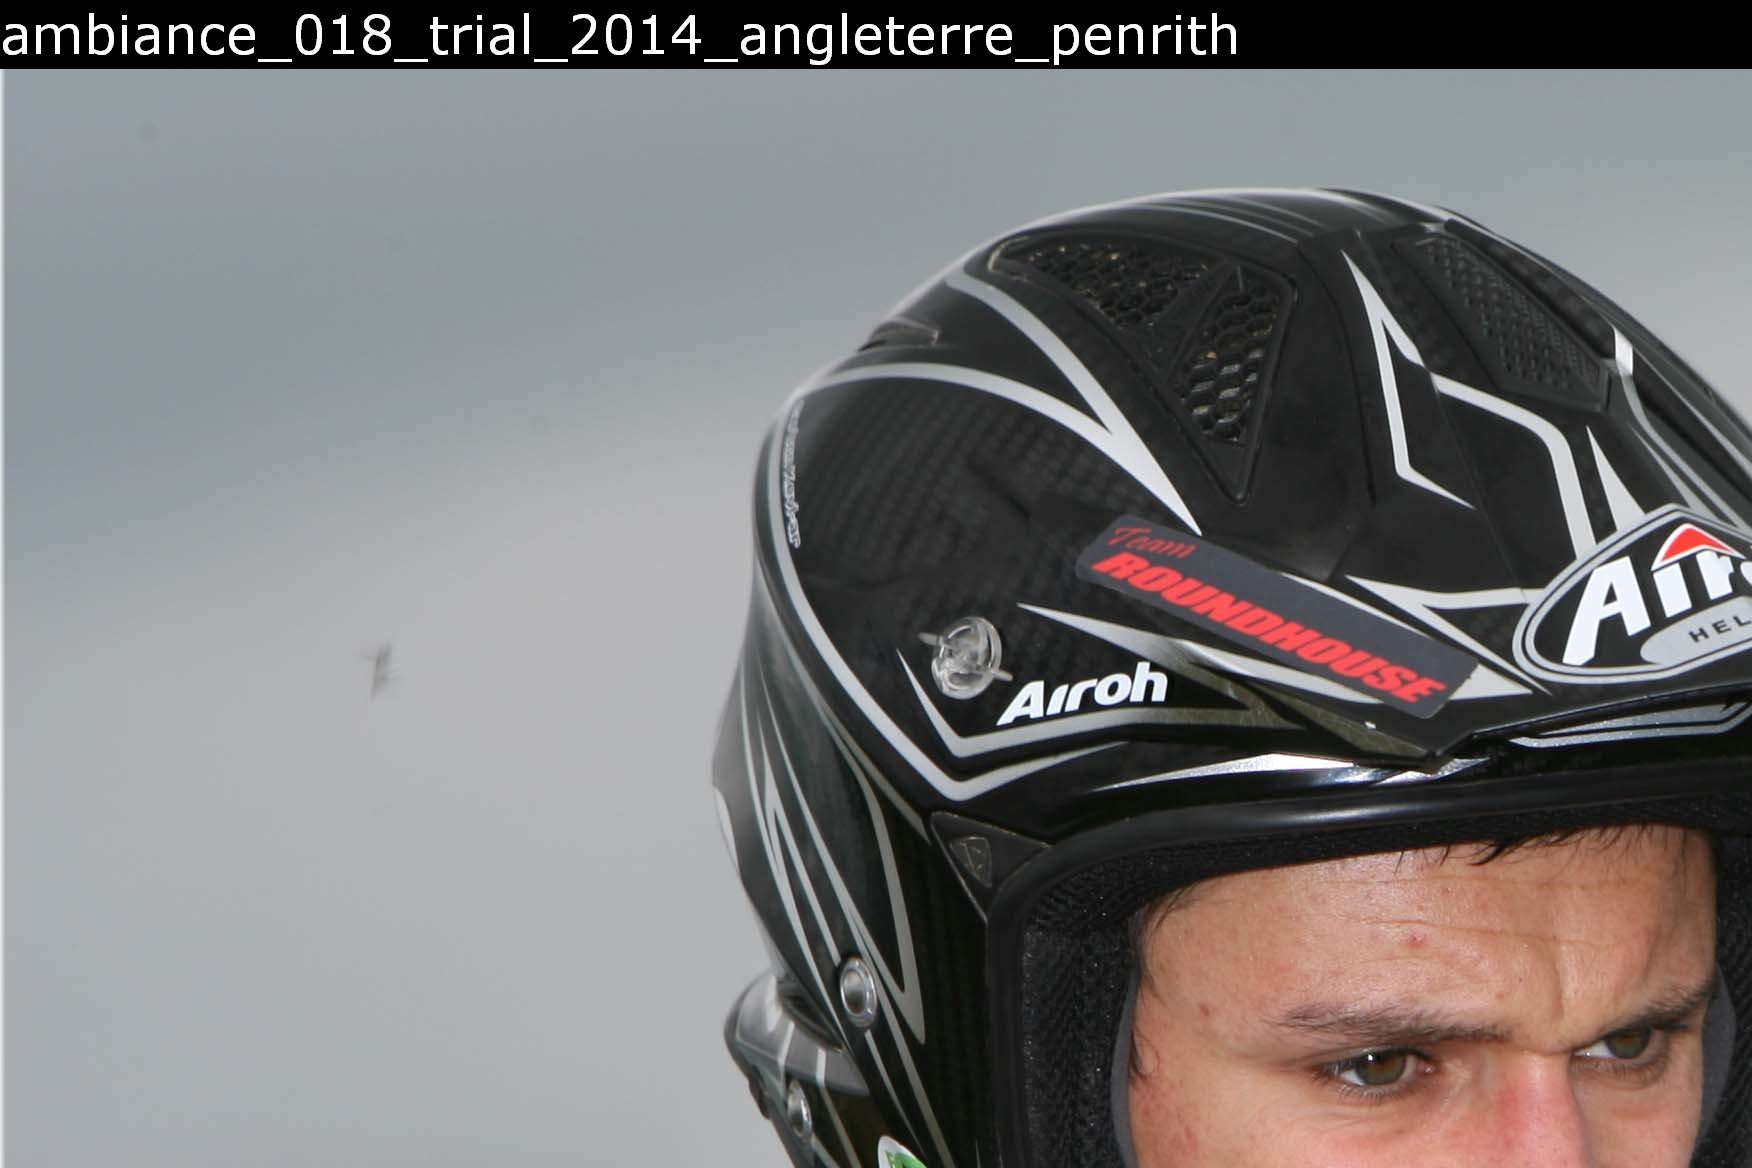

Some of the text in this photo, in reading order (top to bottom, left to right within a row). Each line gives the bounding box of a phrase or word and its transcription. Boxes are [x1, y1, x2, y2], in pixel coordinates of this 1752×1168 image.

[1107, 526, 1196, 559] Team
[1091, 550, 1447, 703] ROUNDHOUSE
[996, 661, 1169, 727] Airoh
